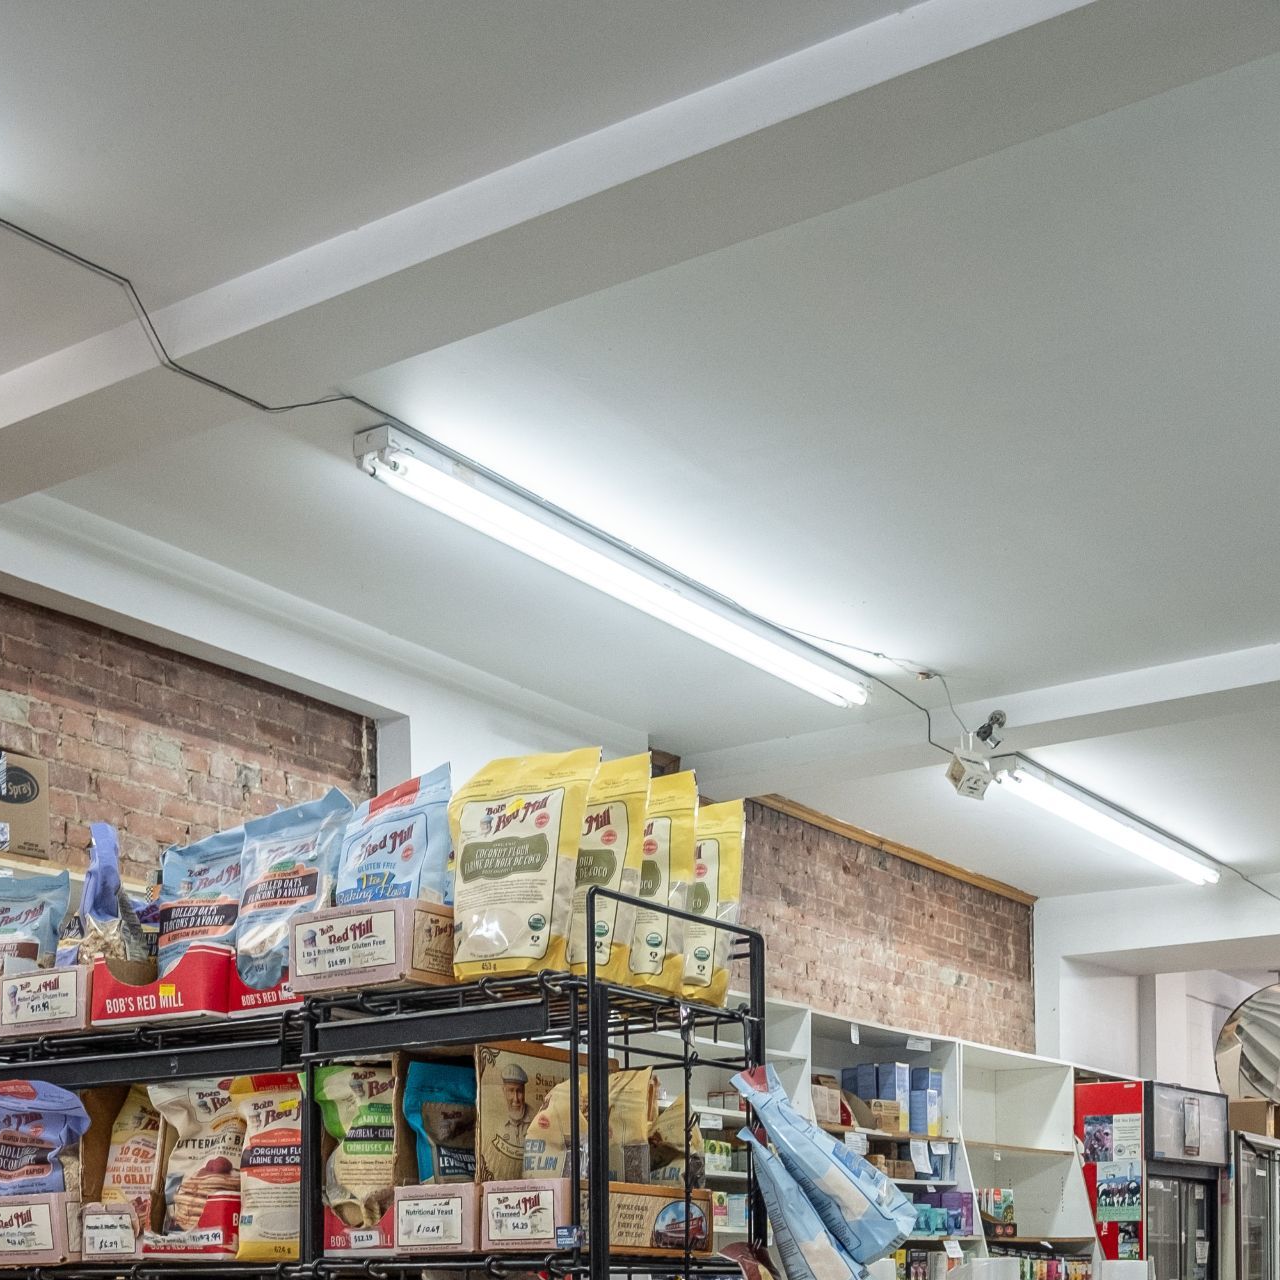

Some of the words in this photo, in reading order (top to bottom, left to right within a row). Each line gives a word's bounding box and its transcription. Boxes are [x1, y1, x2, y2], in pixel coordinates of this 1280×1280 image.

[8, 779, 32, 802] Spray
[519, 794, 551, 824] Mill
[583, 807, 614, 836] Mill
[387, 823, 415, 854] Mill
[475, 846, 507, 860] COCONUT
[507, 843, 531, 856] FLOUR
[523, 852, 542, 866] COCO
[357, 862, 382, 874] GLUTEN
[382, 861, 397, 870] FREE
[588, 867, 609, 879] COCO
[280, 877, 302, 889] OATS
[171, 907, 197, 919] ROLLED
[198, 905, 218, 917] OATS
[328, 929, 349, 946] Red
[350, 916, 373, 942] Mill
[336, 944, 350, 953] Flour
[351, 942, 371, 951] Gluten
[372, 938, 386, 947] Free
[327, 959, 348, 969] $14.99
[37, 975, 60, 993] Mill
[106, 995, 135, 1014] BOB'S
[136, 994, 157, 1012] RED
[159, 991, 184, 1009] MILL
[241, 993, 261, 1007] BOB'S
[262, 991, 278, 1005] RED
[249, 1156, 271, 1165] FARINE
[273, 1155, 284, 1165] DE
[111, 1174, 122, 1185] 10
[520, 1193, 541, 1215] Mill
[13, 1208, 33, 1228] Mill
[405, 1209, 436, 1217] Nutritional
[437, 1208, 453, 1217] Yeast
[496, 1211, 520, 1219] Flaxseed
[200, 1233, 221, 1245] $7.99
